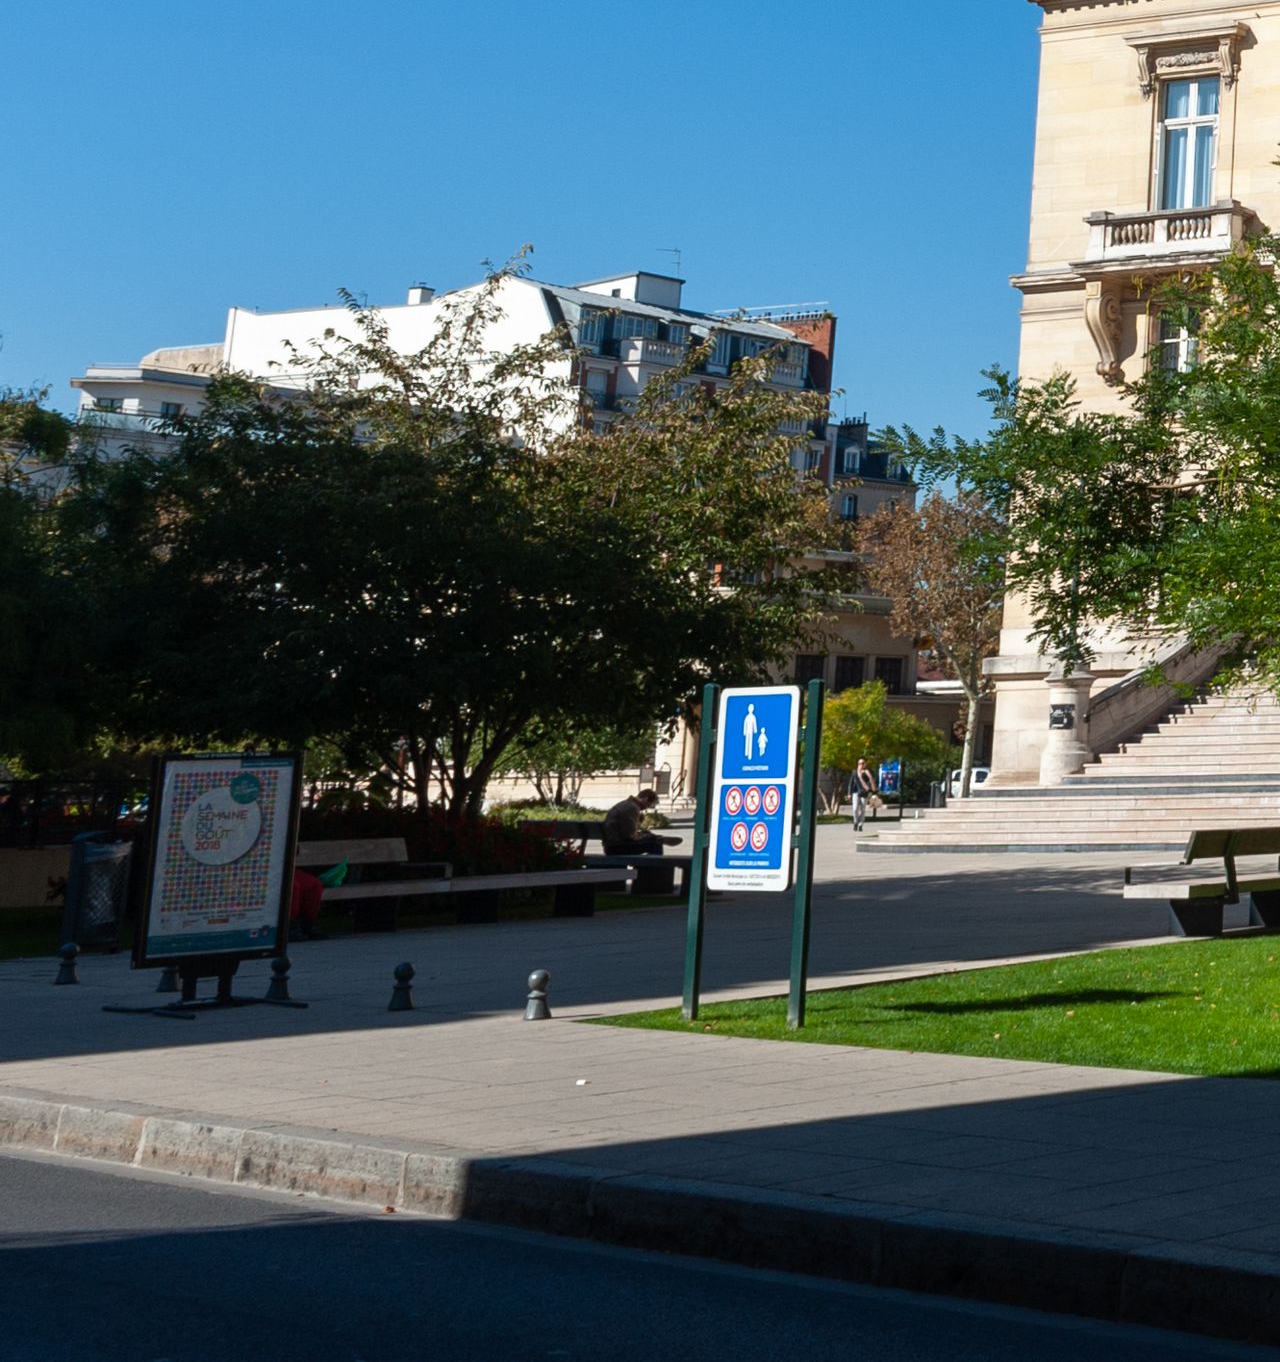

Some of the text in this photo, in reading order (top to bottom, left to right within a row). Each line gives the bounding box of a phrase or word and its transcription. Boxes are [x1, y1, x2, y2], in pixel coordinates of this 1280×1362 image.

[197, 802, 213, 812] LA
[197, 809, 249, 822] SEMAINE
[195, 821, 214, 831] DU
[195, 825, 232, 840] GOÛT
[194, 840, 222, 851] 2018
